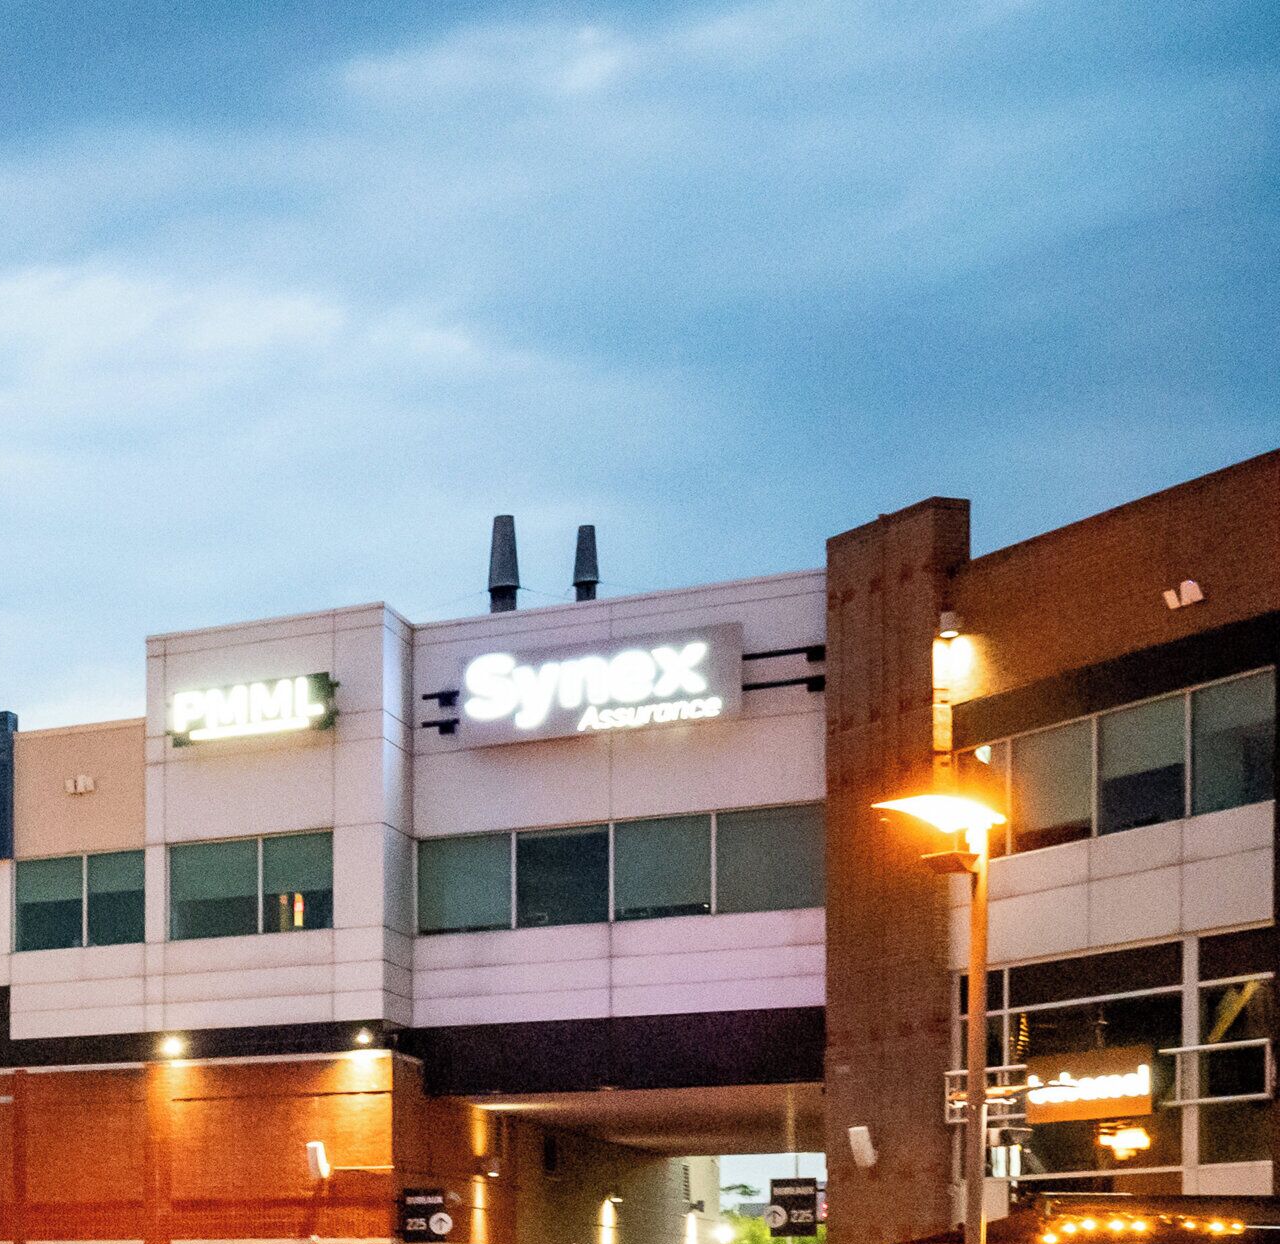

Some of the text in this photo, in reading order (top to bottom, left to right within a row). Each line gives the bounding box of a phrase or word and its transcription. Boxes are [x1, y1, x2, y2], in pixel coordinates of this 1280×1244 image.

[173, 676, 325, 733] PMML
[464, 642, 708, 729] Synex
[577, 697, 724, 731] Assurance
